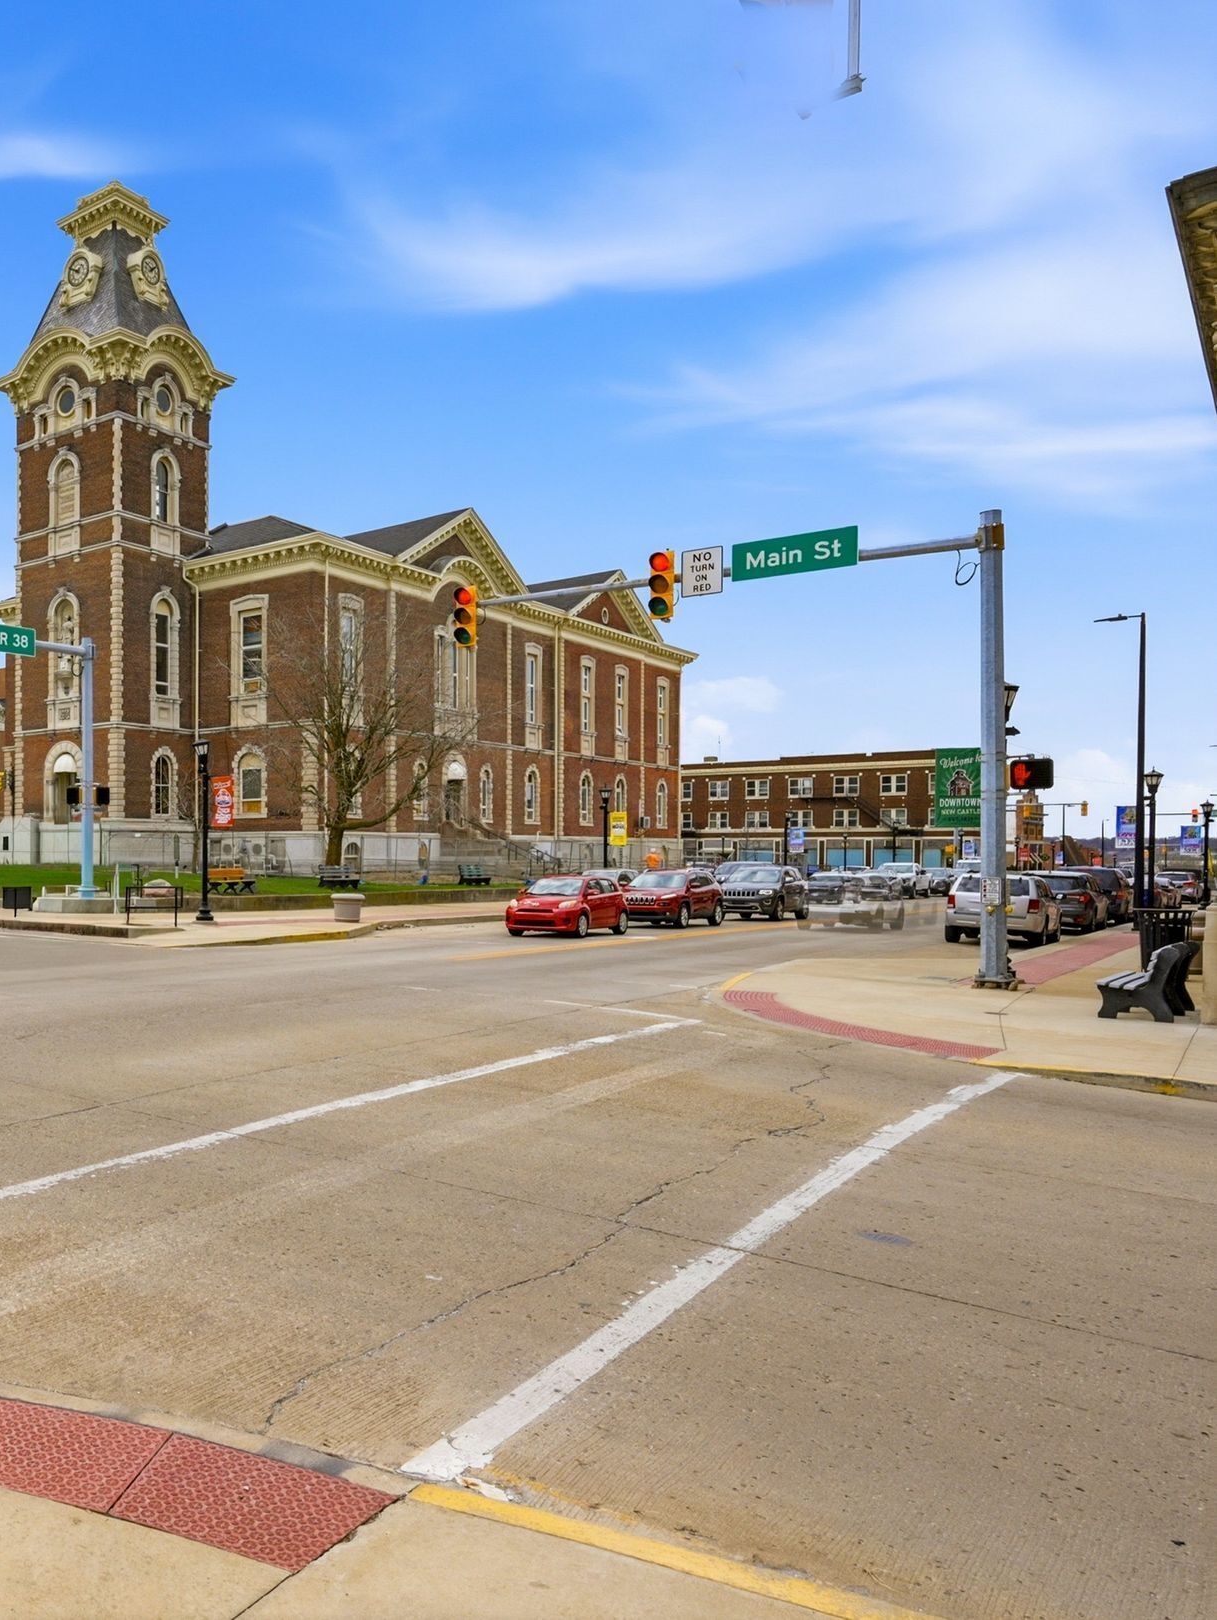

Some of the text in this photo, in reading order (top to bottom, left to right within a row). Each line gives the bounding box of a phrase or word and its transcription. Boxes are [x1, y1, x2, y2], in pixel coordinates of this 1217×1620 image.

[692, 551, 712, 563] NO
[745, 539, 842, 570] Main St
[690, 562, 715, 573] TURN
[695, 574, 708, 582] ON
[693, 583, 712, 592] RED
[12, 633, 28, 648] 38
[939, 756, 973, 768] Welcome
